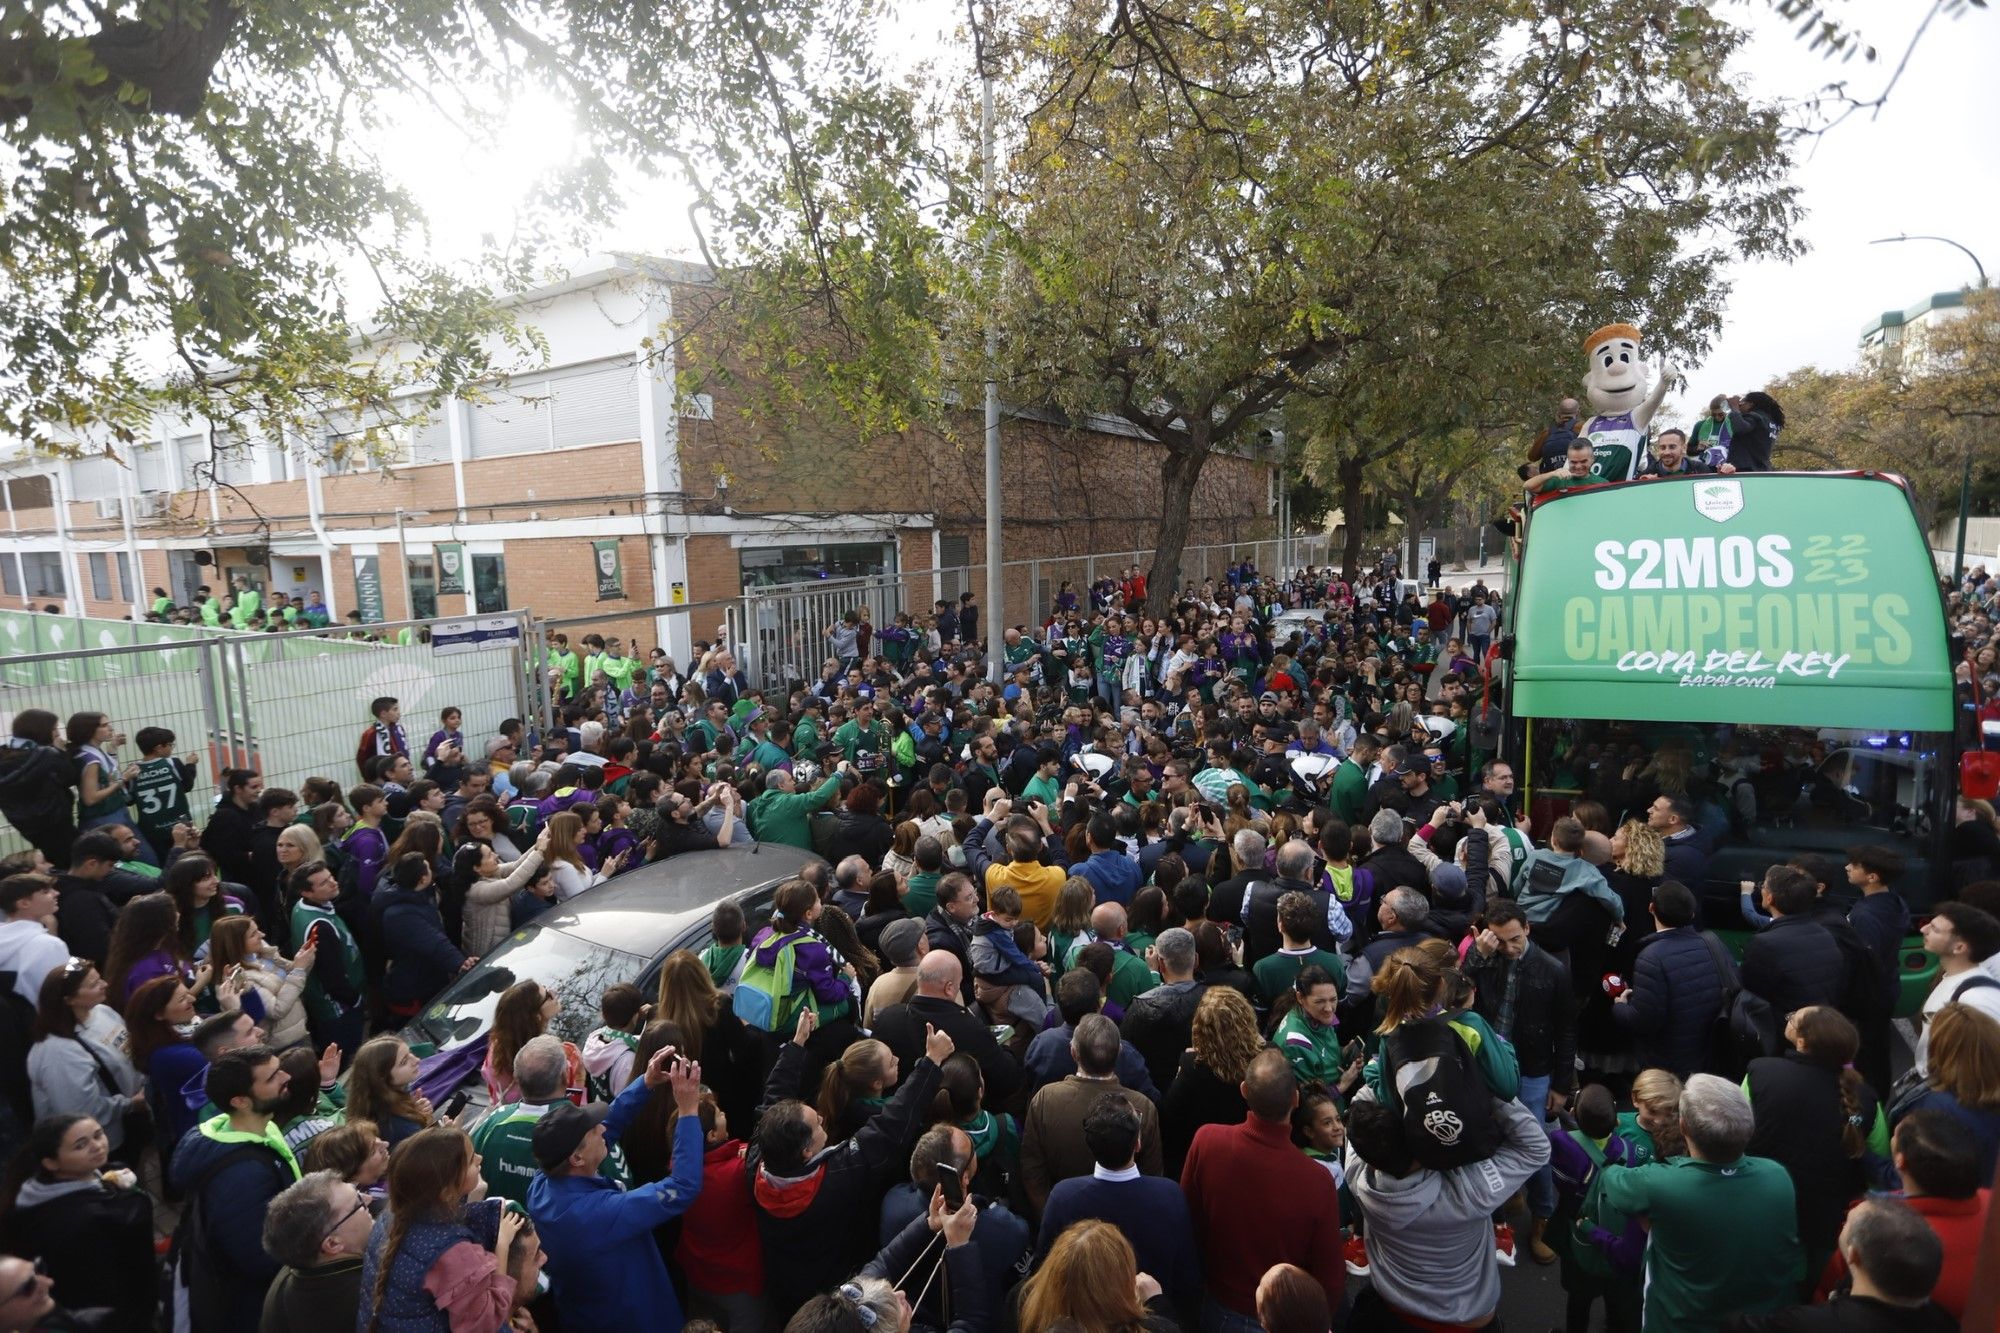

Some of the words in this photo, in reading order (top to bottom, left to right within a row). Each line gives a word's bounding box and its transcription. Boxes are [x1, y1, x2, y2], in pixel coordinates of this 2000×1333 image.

[1802, 534, 1872, 558] 22
[1594, 534, 1794, 590] S2MOS
[1804, 558, 1870, 586] 23
[1564, 594, 1912, 665] CAMPEONES
[1616, 650, 1697, 674] COPA
[1701, 649, 1775, 674] DEL
[1776, 651, 1851, 679] REY
[1678, 674, 1776, 689] BADALONA
[138, 783, 177, 814] 37
[499, 1157, 537, 1177] humm
